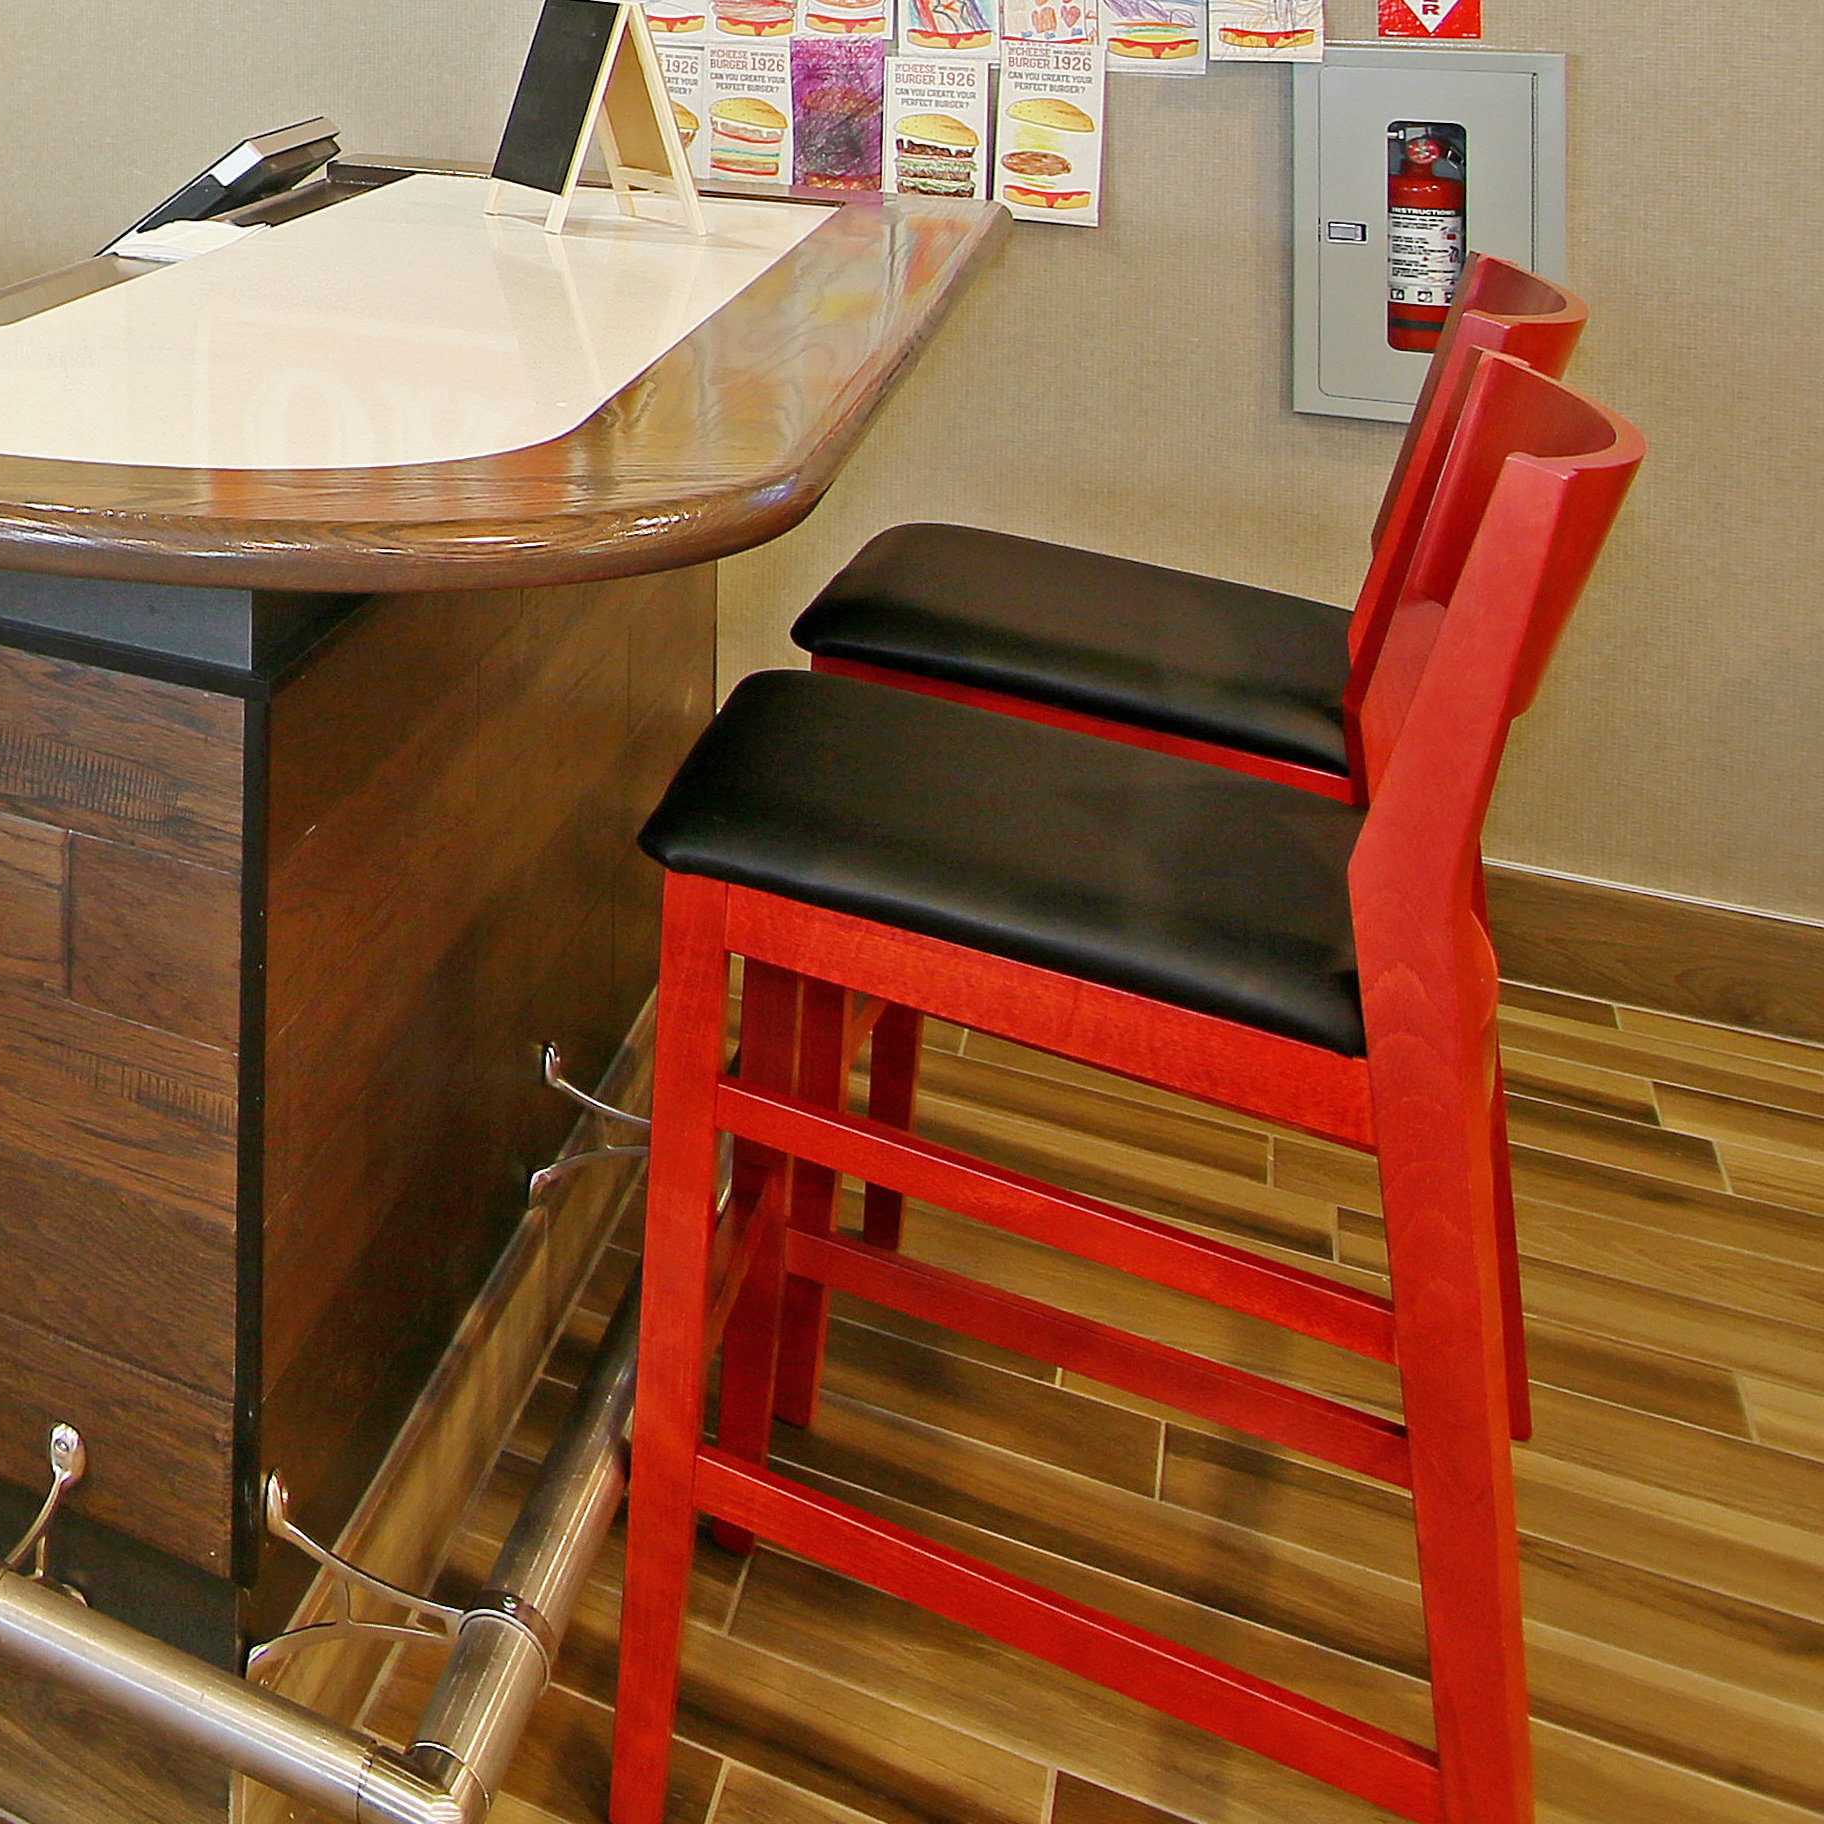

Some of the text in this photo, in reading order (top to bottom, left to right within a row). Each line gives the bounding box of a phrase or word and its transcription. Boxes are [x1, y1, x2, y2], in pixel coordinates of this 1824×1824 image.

[710, 57, 785, 72] BURGER 1926
[1008, 55, 1092, 72] BURGER 1926
